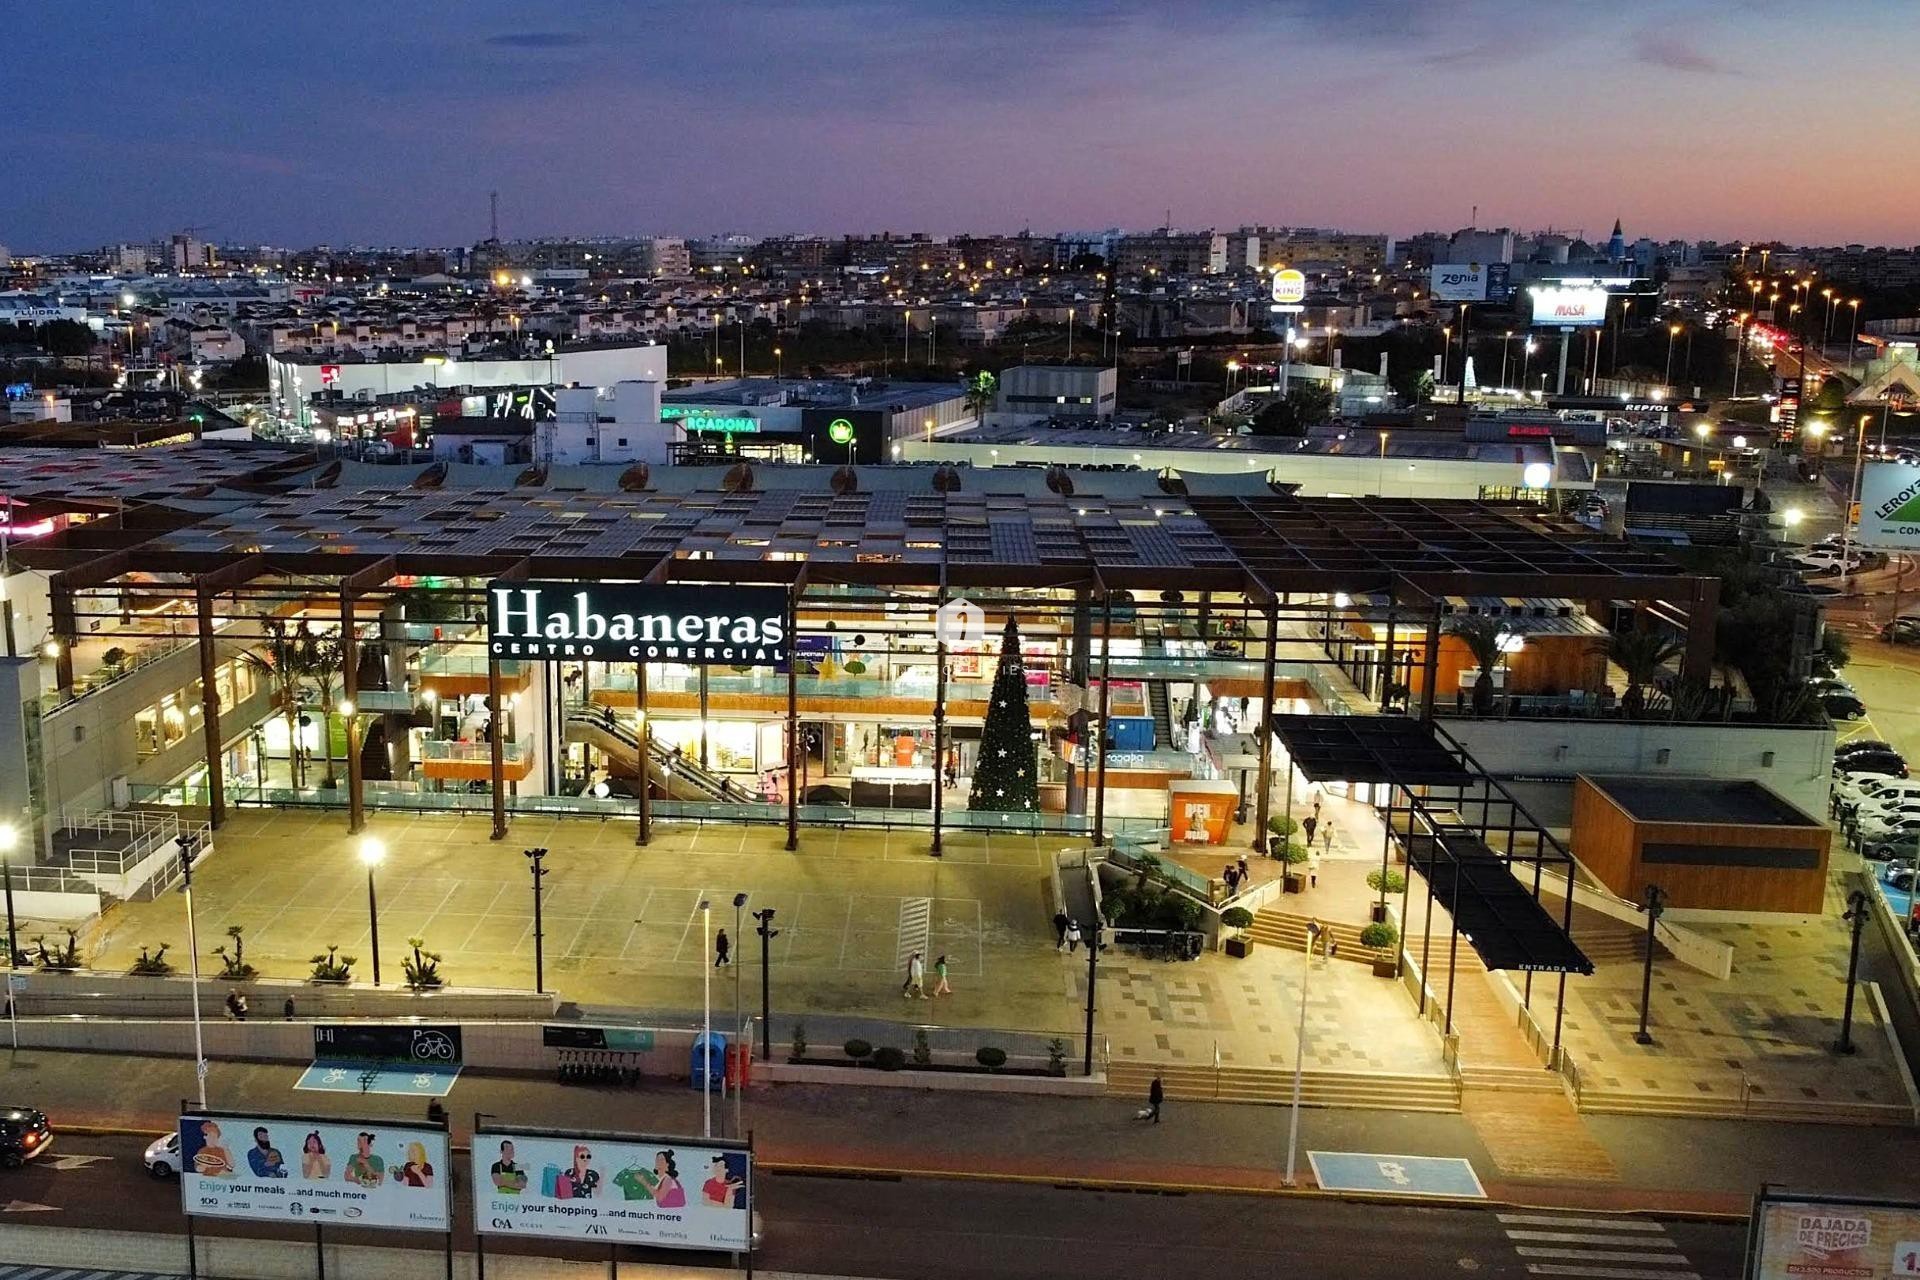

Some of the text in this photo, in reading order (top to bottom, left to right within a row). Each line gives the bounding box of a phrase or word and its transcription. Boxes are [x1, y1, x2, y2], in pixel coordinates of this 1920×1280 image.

[1554, 303, 1586, 317] MASA
[1625, 403, 1669, 412] REPSOL
[492, 588, 784, 646] Habaneras
[492, 642, 784, 661] CENTRO COMERCIAL
[1519, 963, 1567, 972] ENTRADA
[413, 1030, 423, 1041] P
[199, 1179, 227, 1194] Enjoy
[229, 1183, 252, 1196] your
[254, 1185, 286, 1196] meals
[315, 1189, 341, 1199] much
[343, 1191, 367, 1201] more
[491, 1200, 520, 1216] Enjoy
[522, 1203, 546, 1216] your
[548, 1204, 598, 1218] shopping
[628, 1210, 655, 1220] much
[656, 1212, 682, 1222] more
[491, 1217, 513, 1230] C&A
[1801, 1217, 1867, 1232] BAJADA
[1800, 1230, 1867, 1247] DE PRECIOS
[1823, 1267, 1871, 1277] PRODUCTOS
